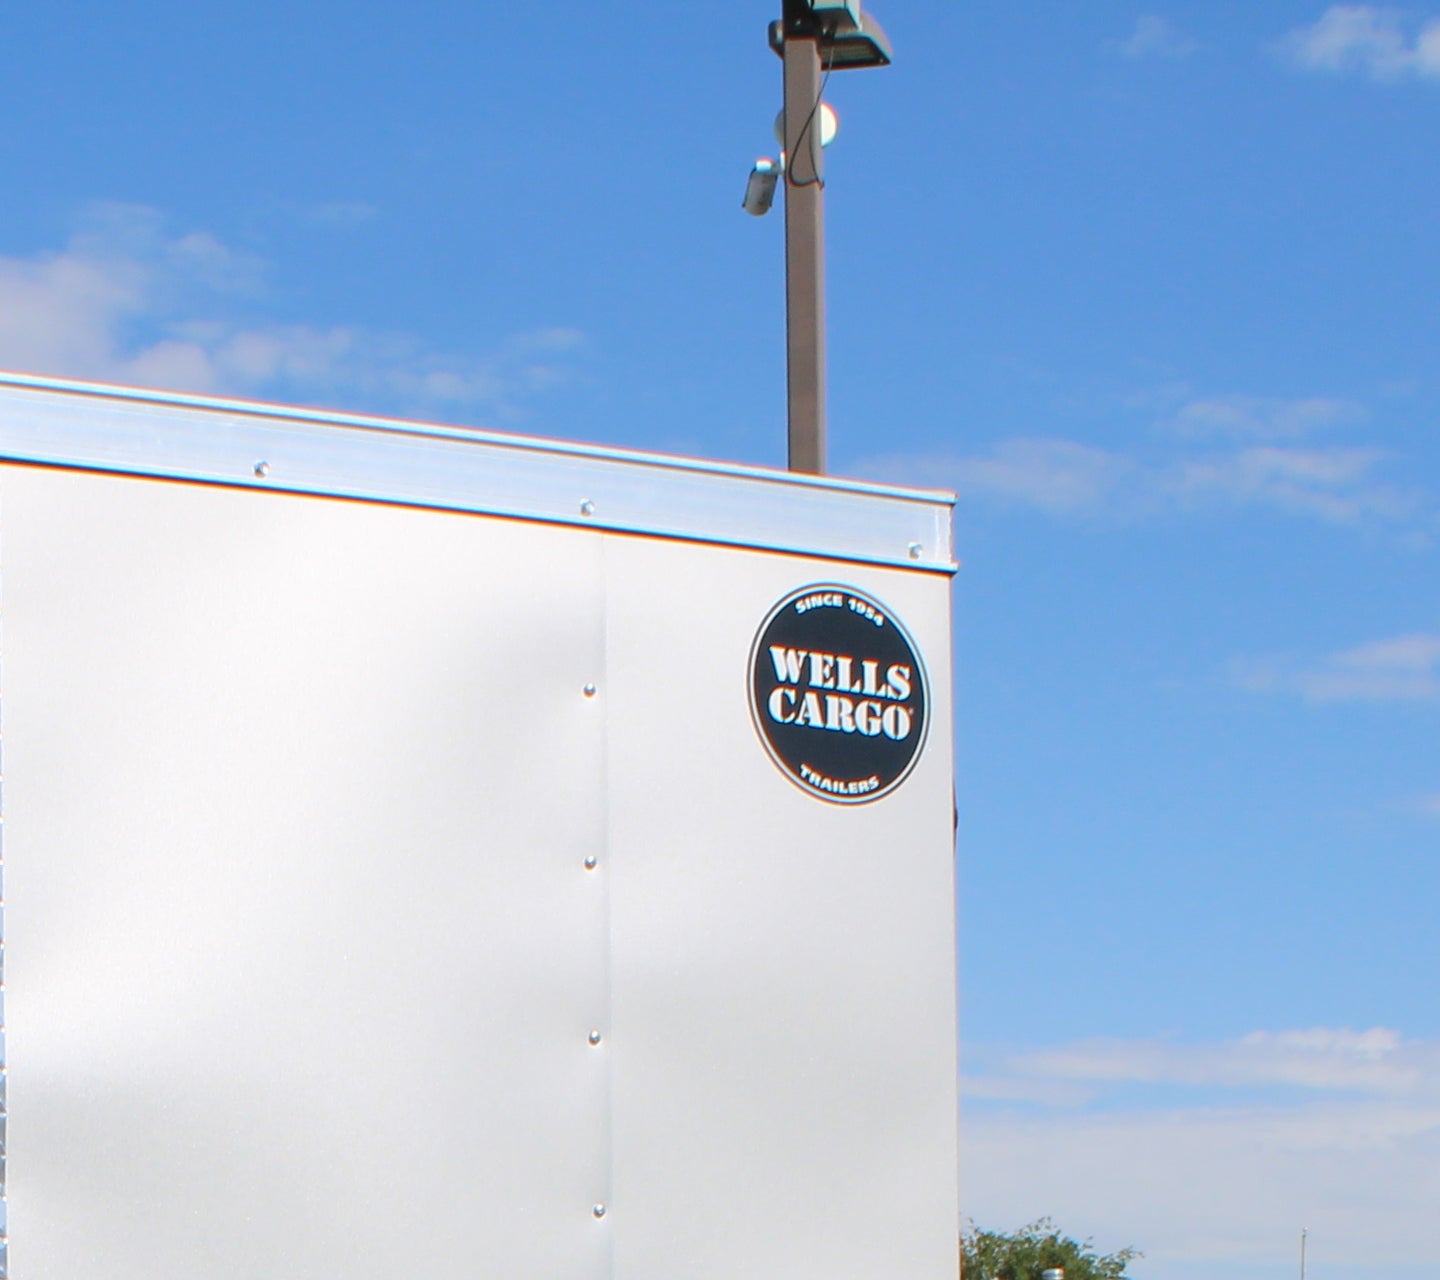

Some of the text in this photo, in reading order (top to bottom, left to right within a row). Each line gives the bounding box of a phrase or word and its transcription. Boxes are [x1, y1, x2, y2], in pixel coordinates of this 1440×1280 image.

[795, 593, 884, 627] SINCE 1954
[769, 646, 911, 700] WELLS
[768, 687, 911, 741] CARGO
[799, 763, 880, 794] TRAILERS
